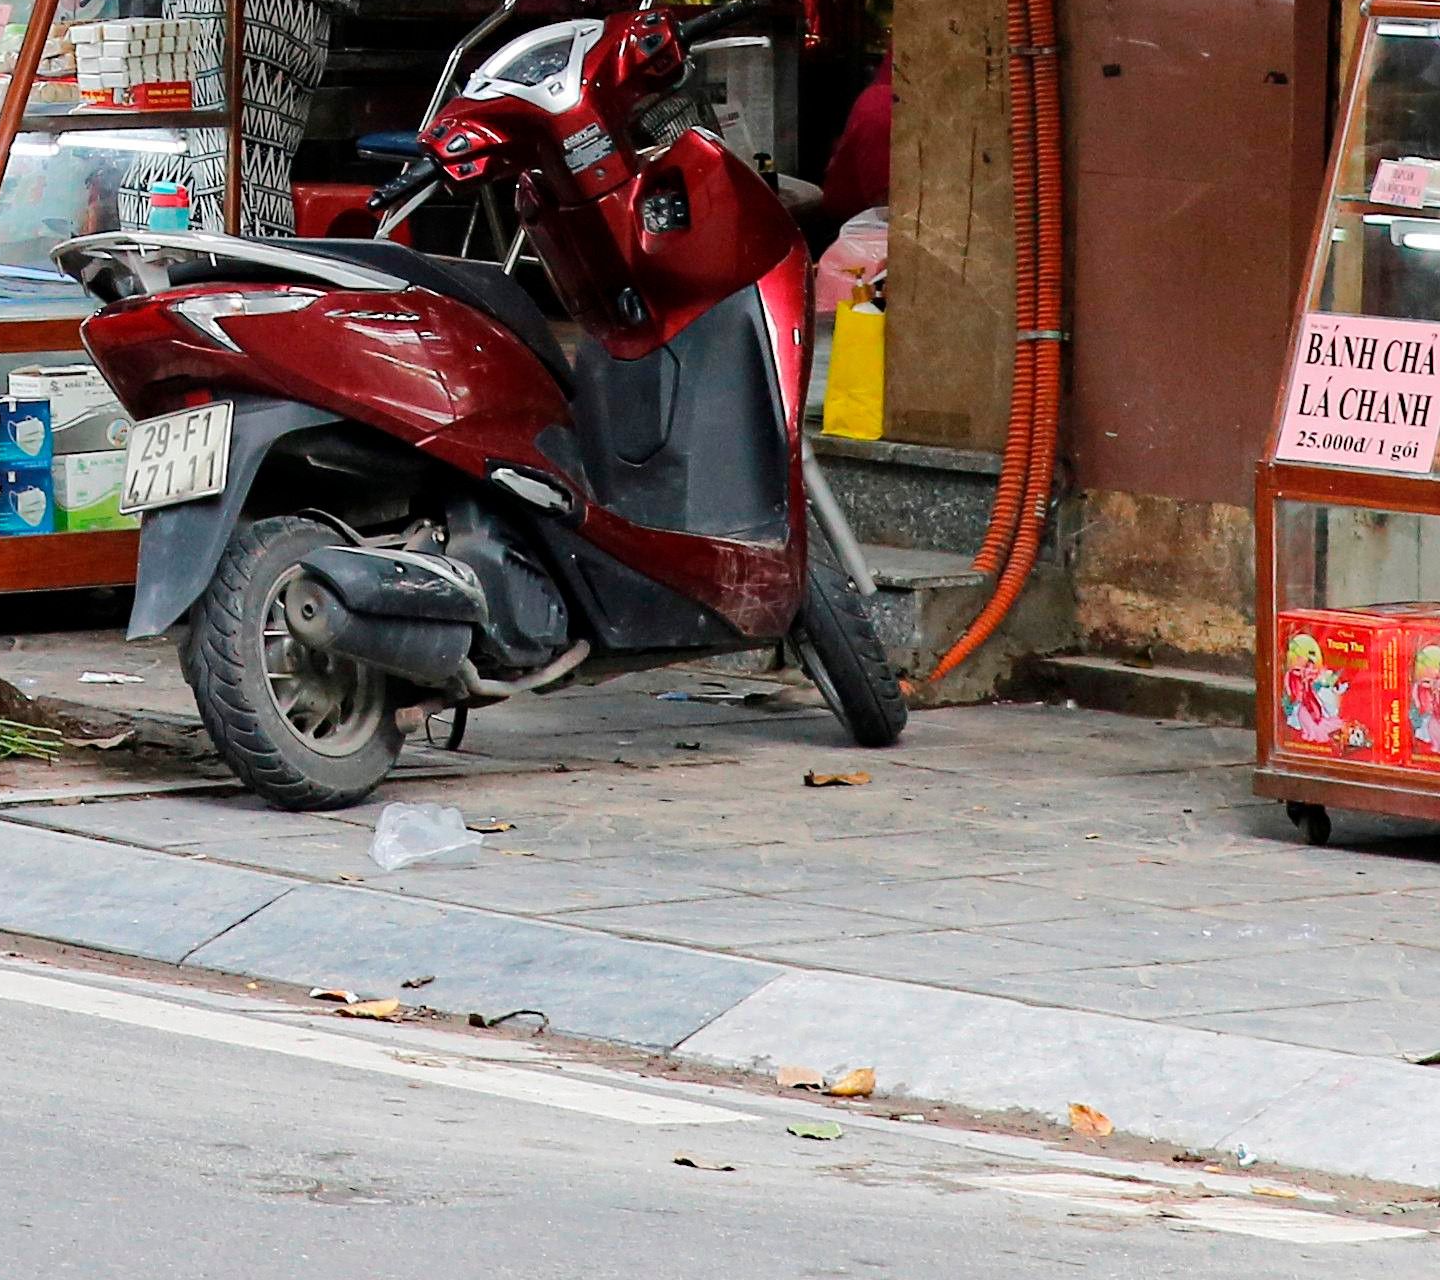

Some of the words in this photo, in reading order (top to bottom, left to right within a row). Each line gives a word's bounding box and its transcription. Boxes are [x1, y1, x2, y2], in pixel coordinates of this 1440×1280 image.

[1305, 324, 1379, 371] BÁNH
[1383, 332, 1437, 376] CHẢ
[1298, 375, 1333, 418] LÁ
[1339, 387, 1432, 428] CHANH
[139, 410, 214, 462] 29-F1
[1295, 429, 1371, 454] 25.000đ/
[1377, 440, 1386, 456] 1
[1391, 440, 1420, 462] gói
[126, 450, 217, 504] 471.11
[1350, 640, 1365, 653] Thu
